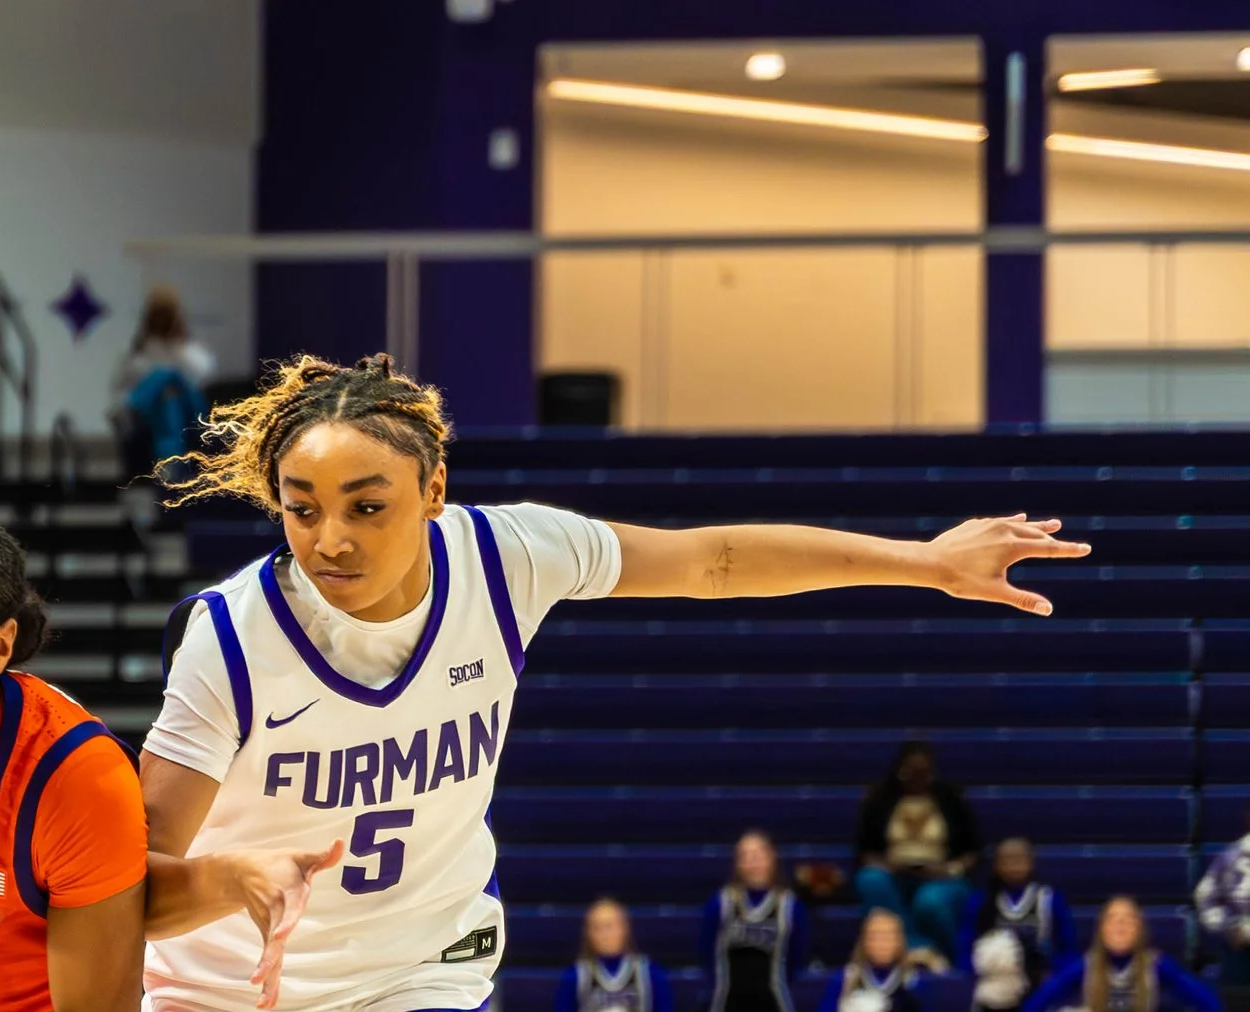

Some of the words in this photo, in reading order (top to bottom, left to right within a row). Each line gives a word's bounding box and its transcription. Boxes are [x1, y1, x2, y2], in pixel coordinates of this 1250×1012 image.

[264, 701, 499, 809] FURMAN
[341, 809, 414, 895] 5
[482, 936, 492, 950] M
